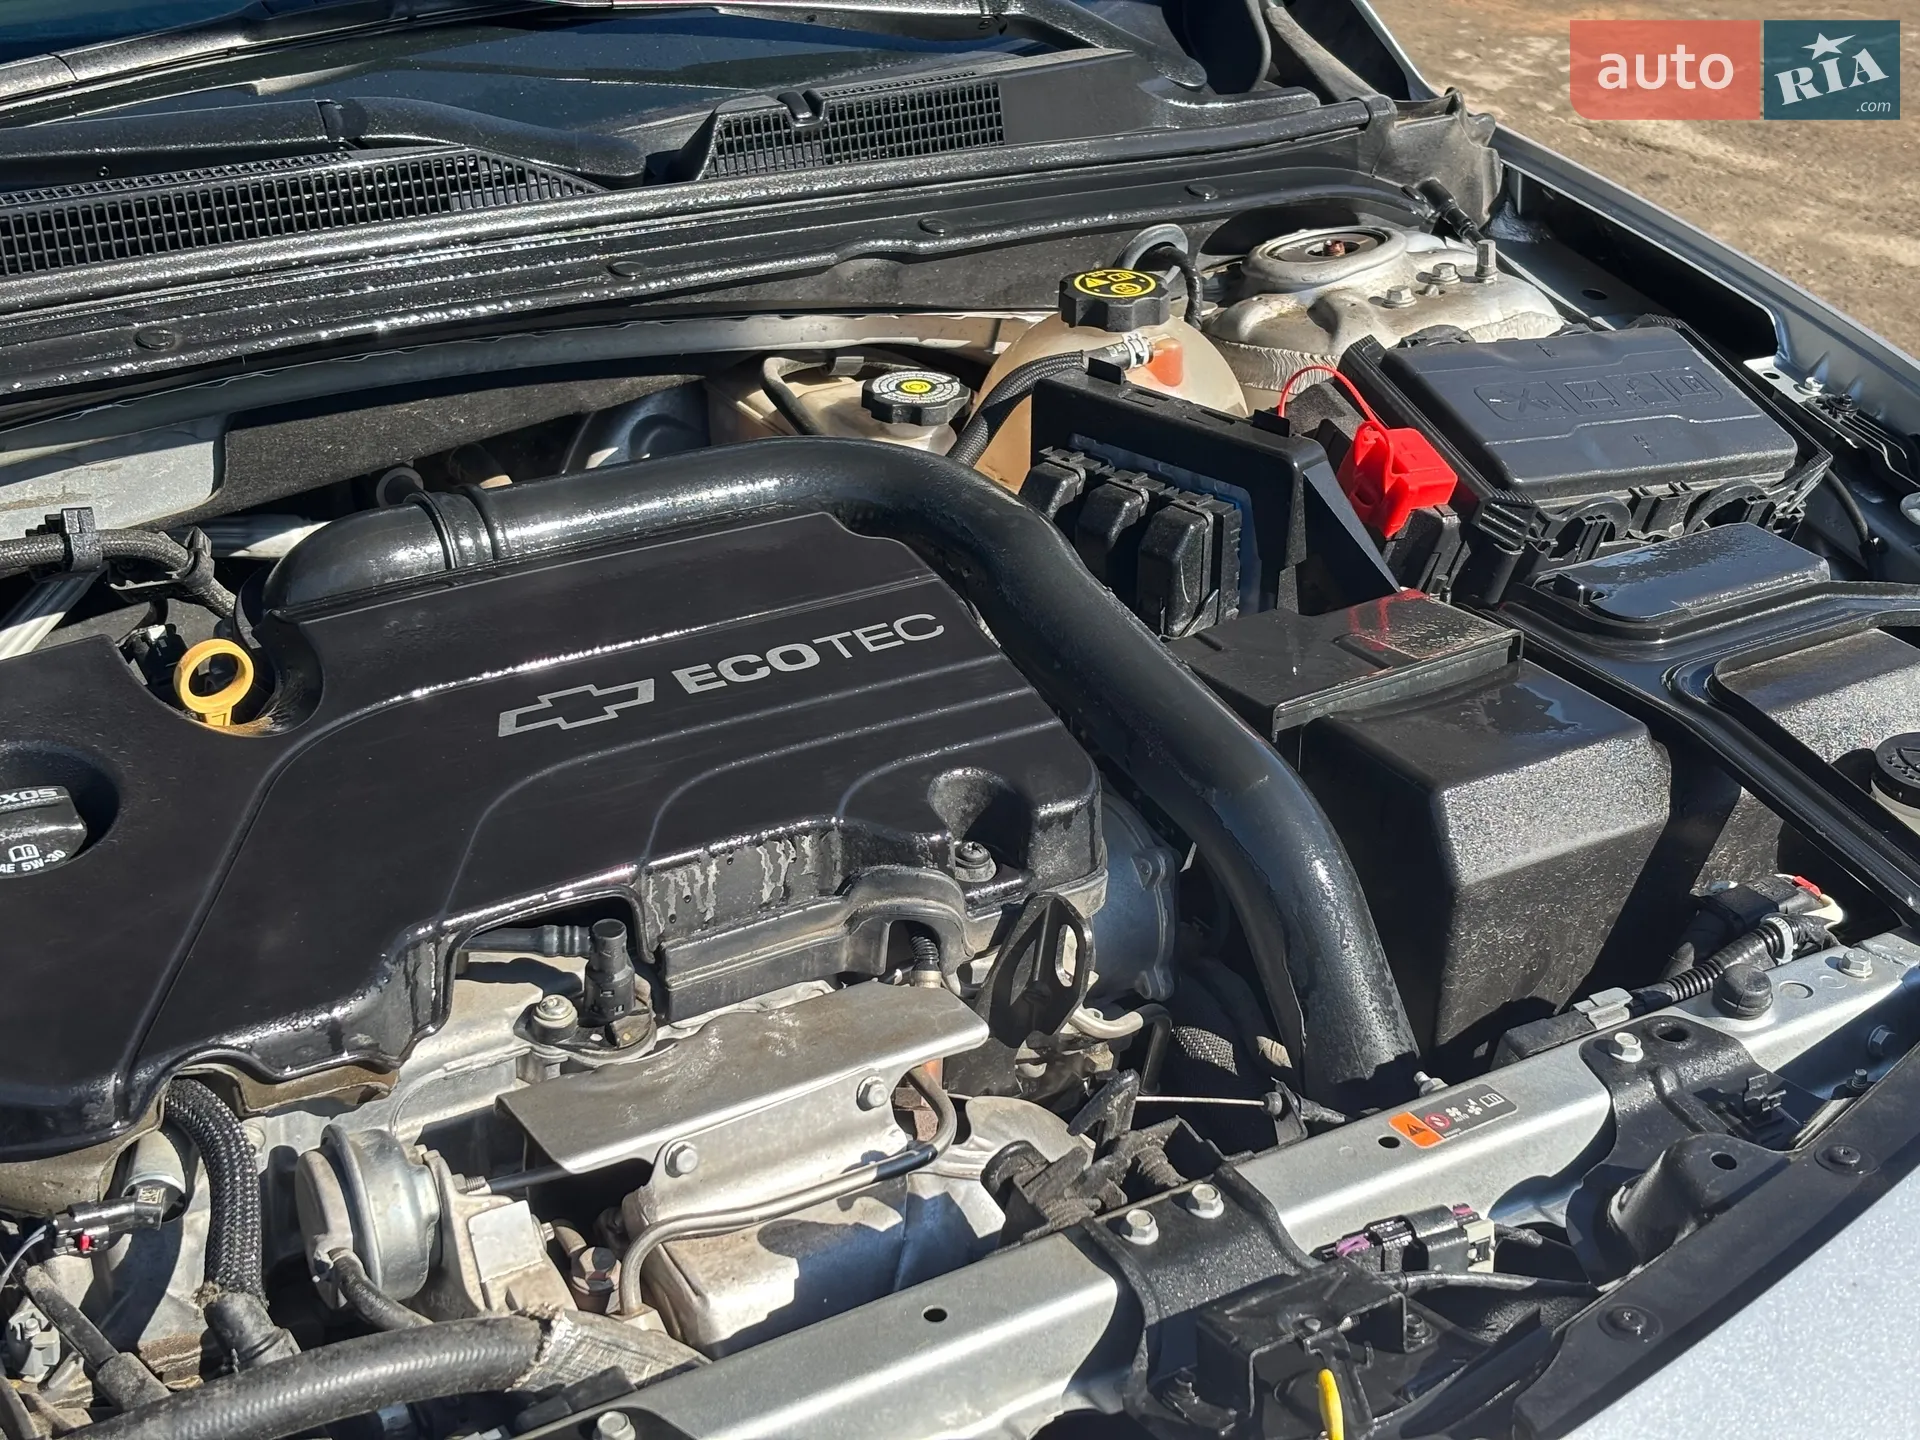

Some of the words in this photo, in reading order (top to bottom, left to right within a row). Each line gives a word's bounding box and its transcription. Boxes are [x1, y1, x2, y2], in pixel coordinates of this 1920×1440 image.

[671, 613, 945, 694] ECOTEC
[0, 863, 16, 874] AE
[21, 849, 67, 872] 5W-30
